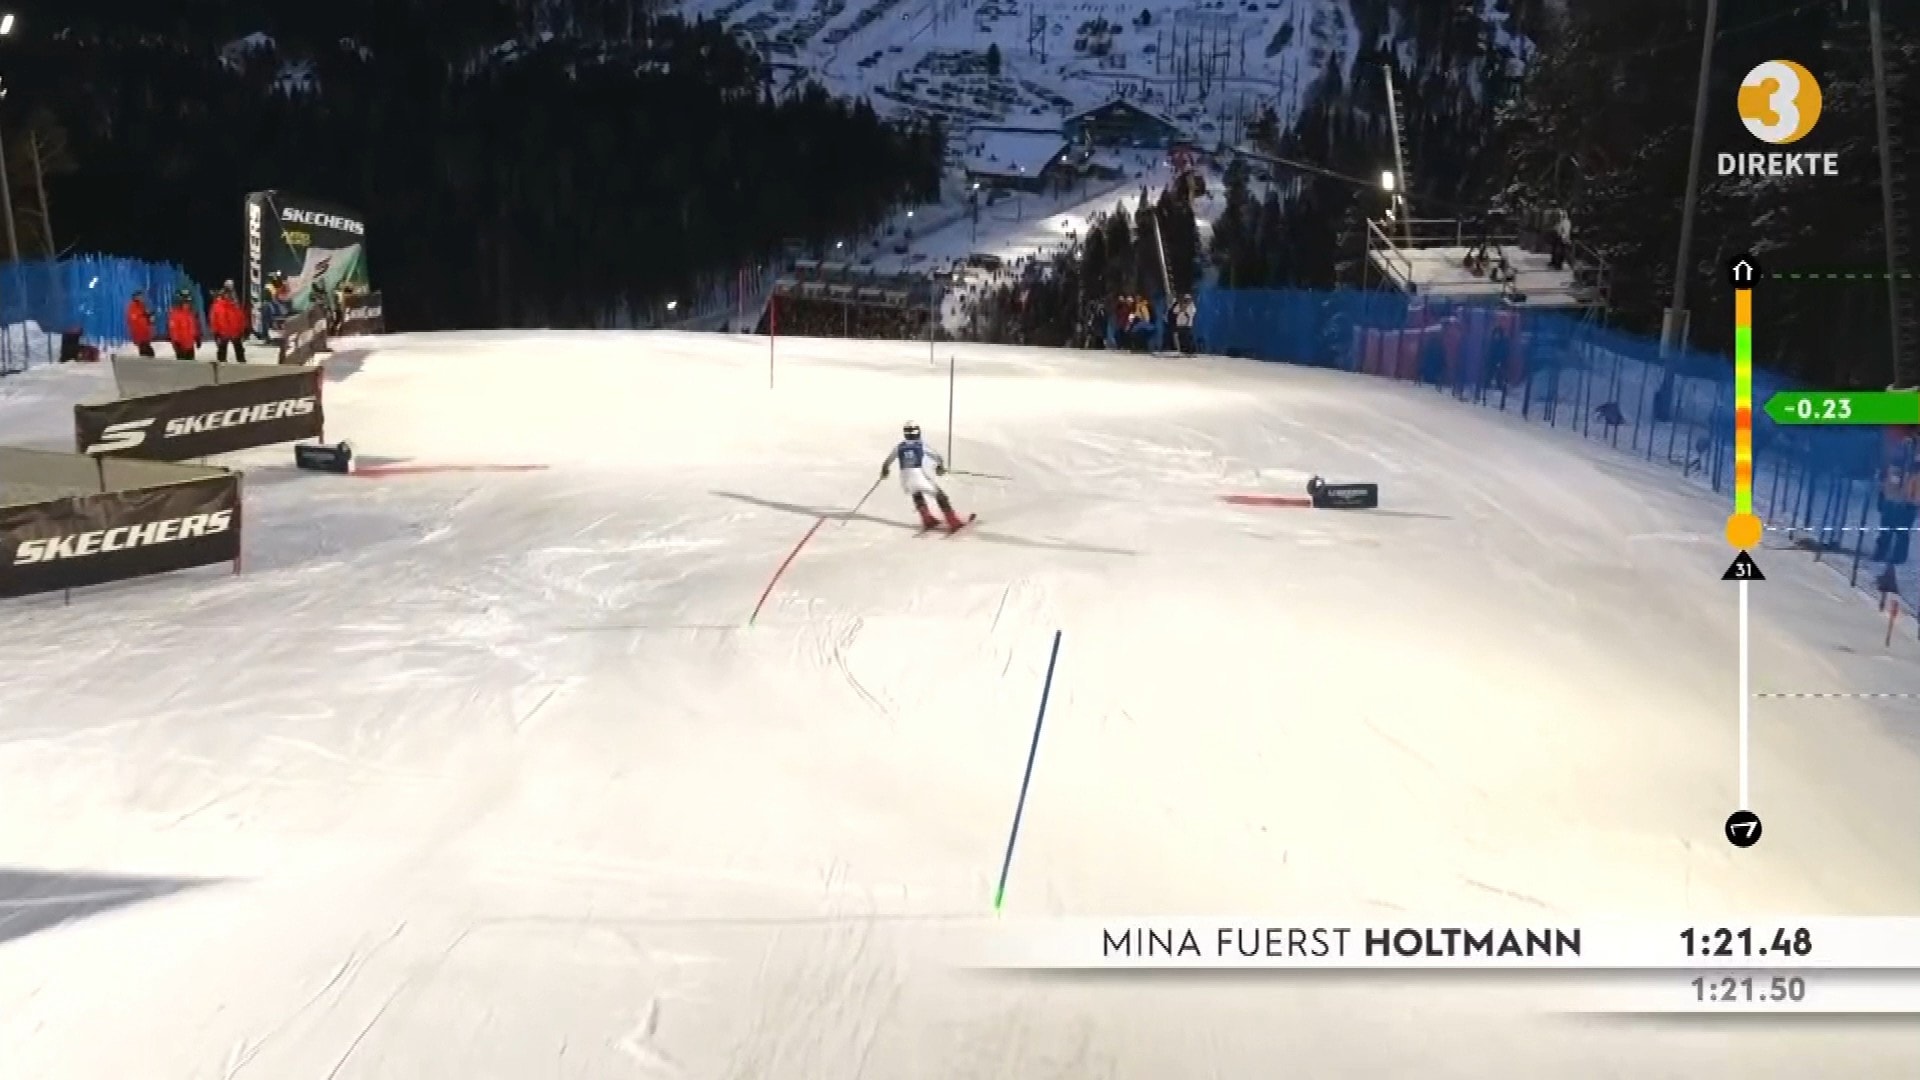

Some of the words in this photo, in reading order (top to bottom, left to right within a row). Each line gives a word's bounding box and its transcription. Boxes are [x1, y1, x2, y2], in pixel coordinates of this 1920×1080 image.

[281, 207, 365, 235] SKECHERS
[163, 396, 316, 438] SKECHERS
[13, 508, 233, 565] SKECHERS
